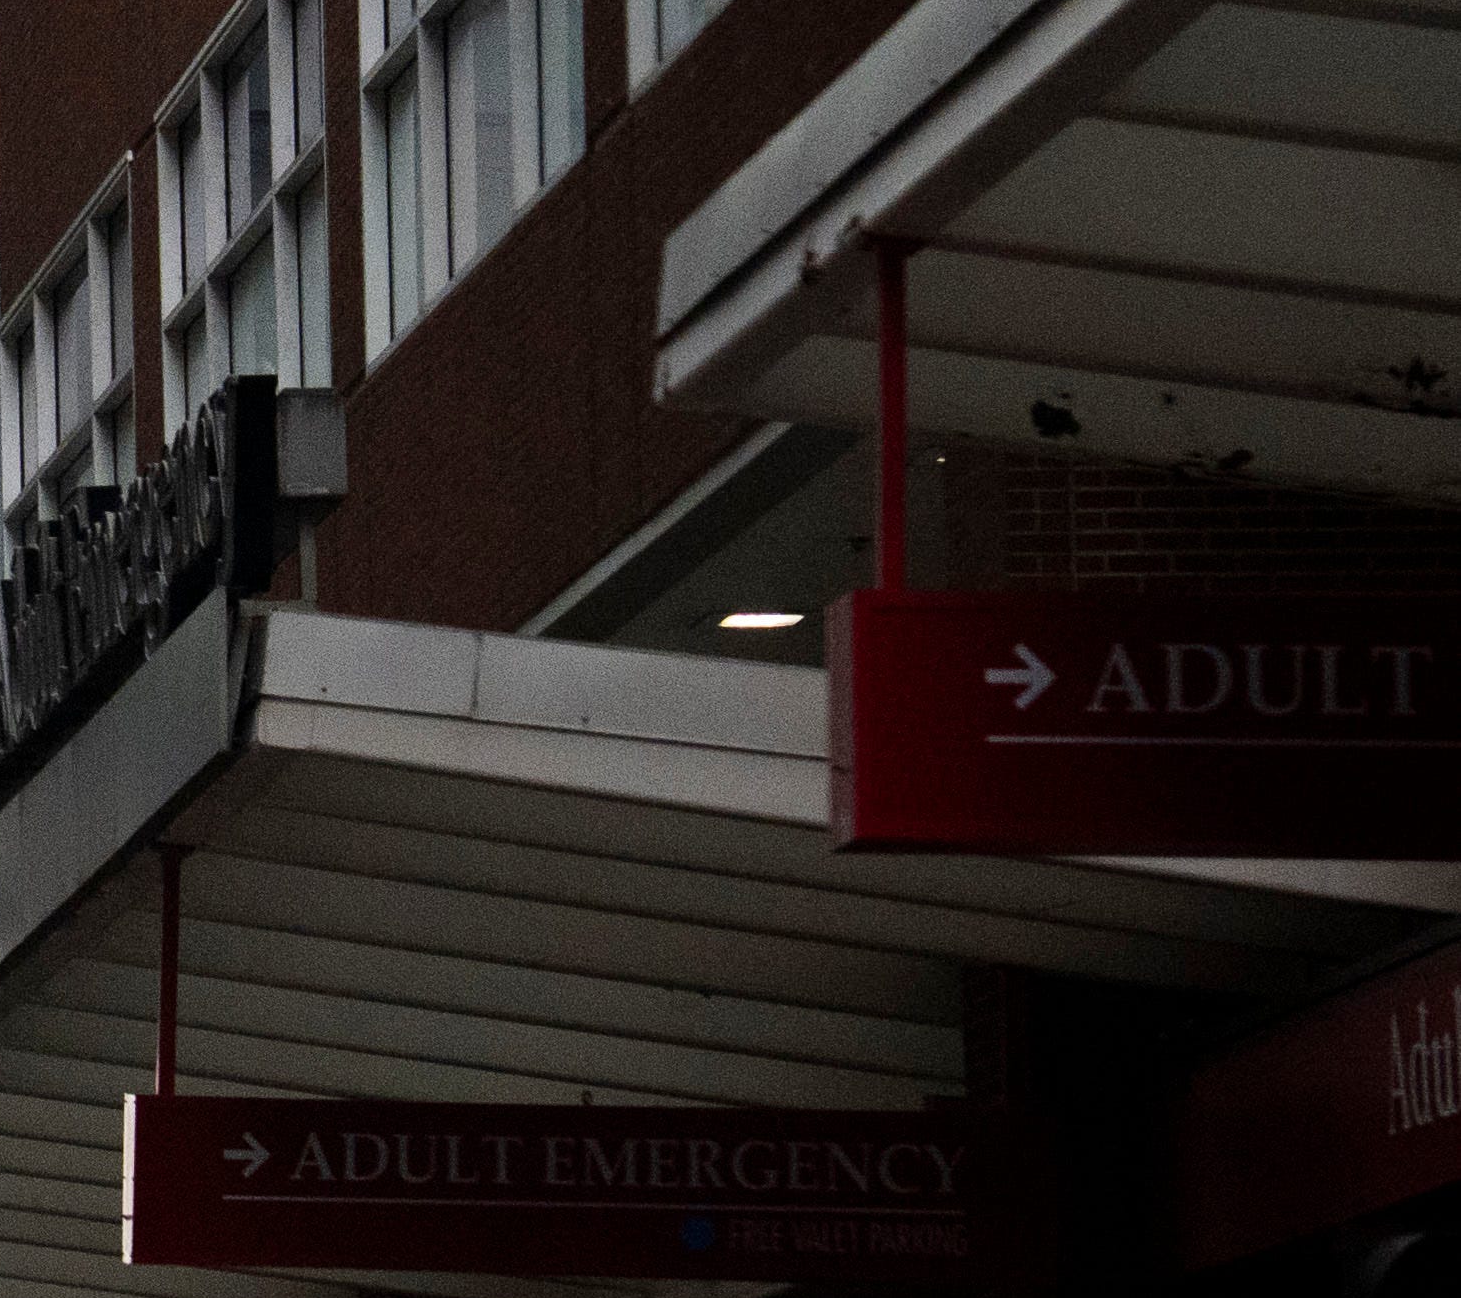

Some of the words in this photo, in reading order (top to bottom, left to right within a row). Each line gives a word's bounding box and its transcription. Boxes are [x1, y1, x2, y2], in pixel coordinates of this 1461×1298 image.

[1084, 641, 1434, 717] ADULT
[290, 1131, 521, 1185] ADULT
[545, 1138, 966, 1196] EMERGENCY
[728, 1219, 783, 1253] FREE
[790, 1220, 862, 1256] VALET
[868, 1221, 969, 1257] PARKING
